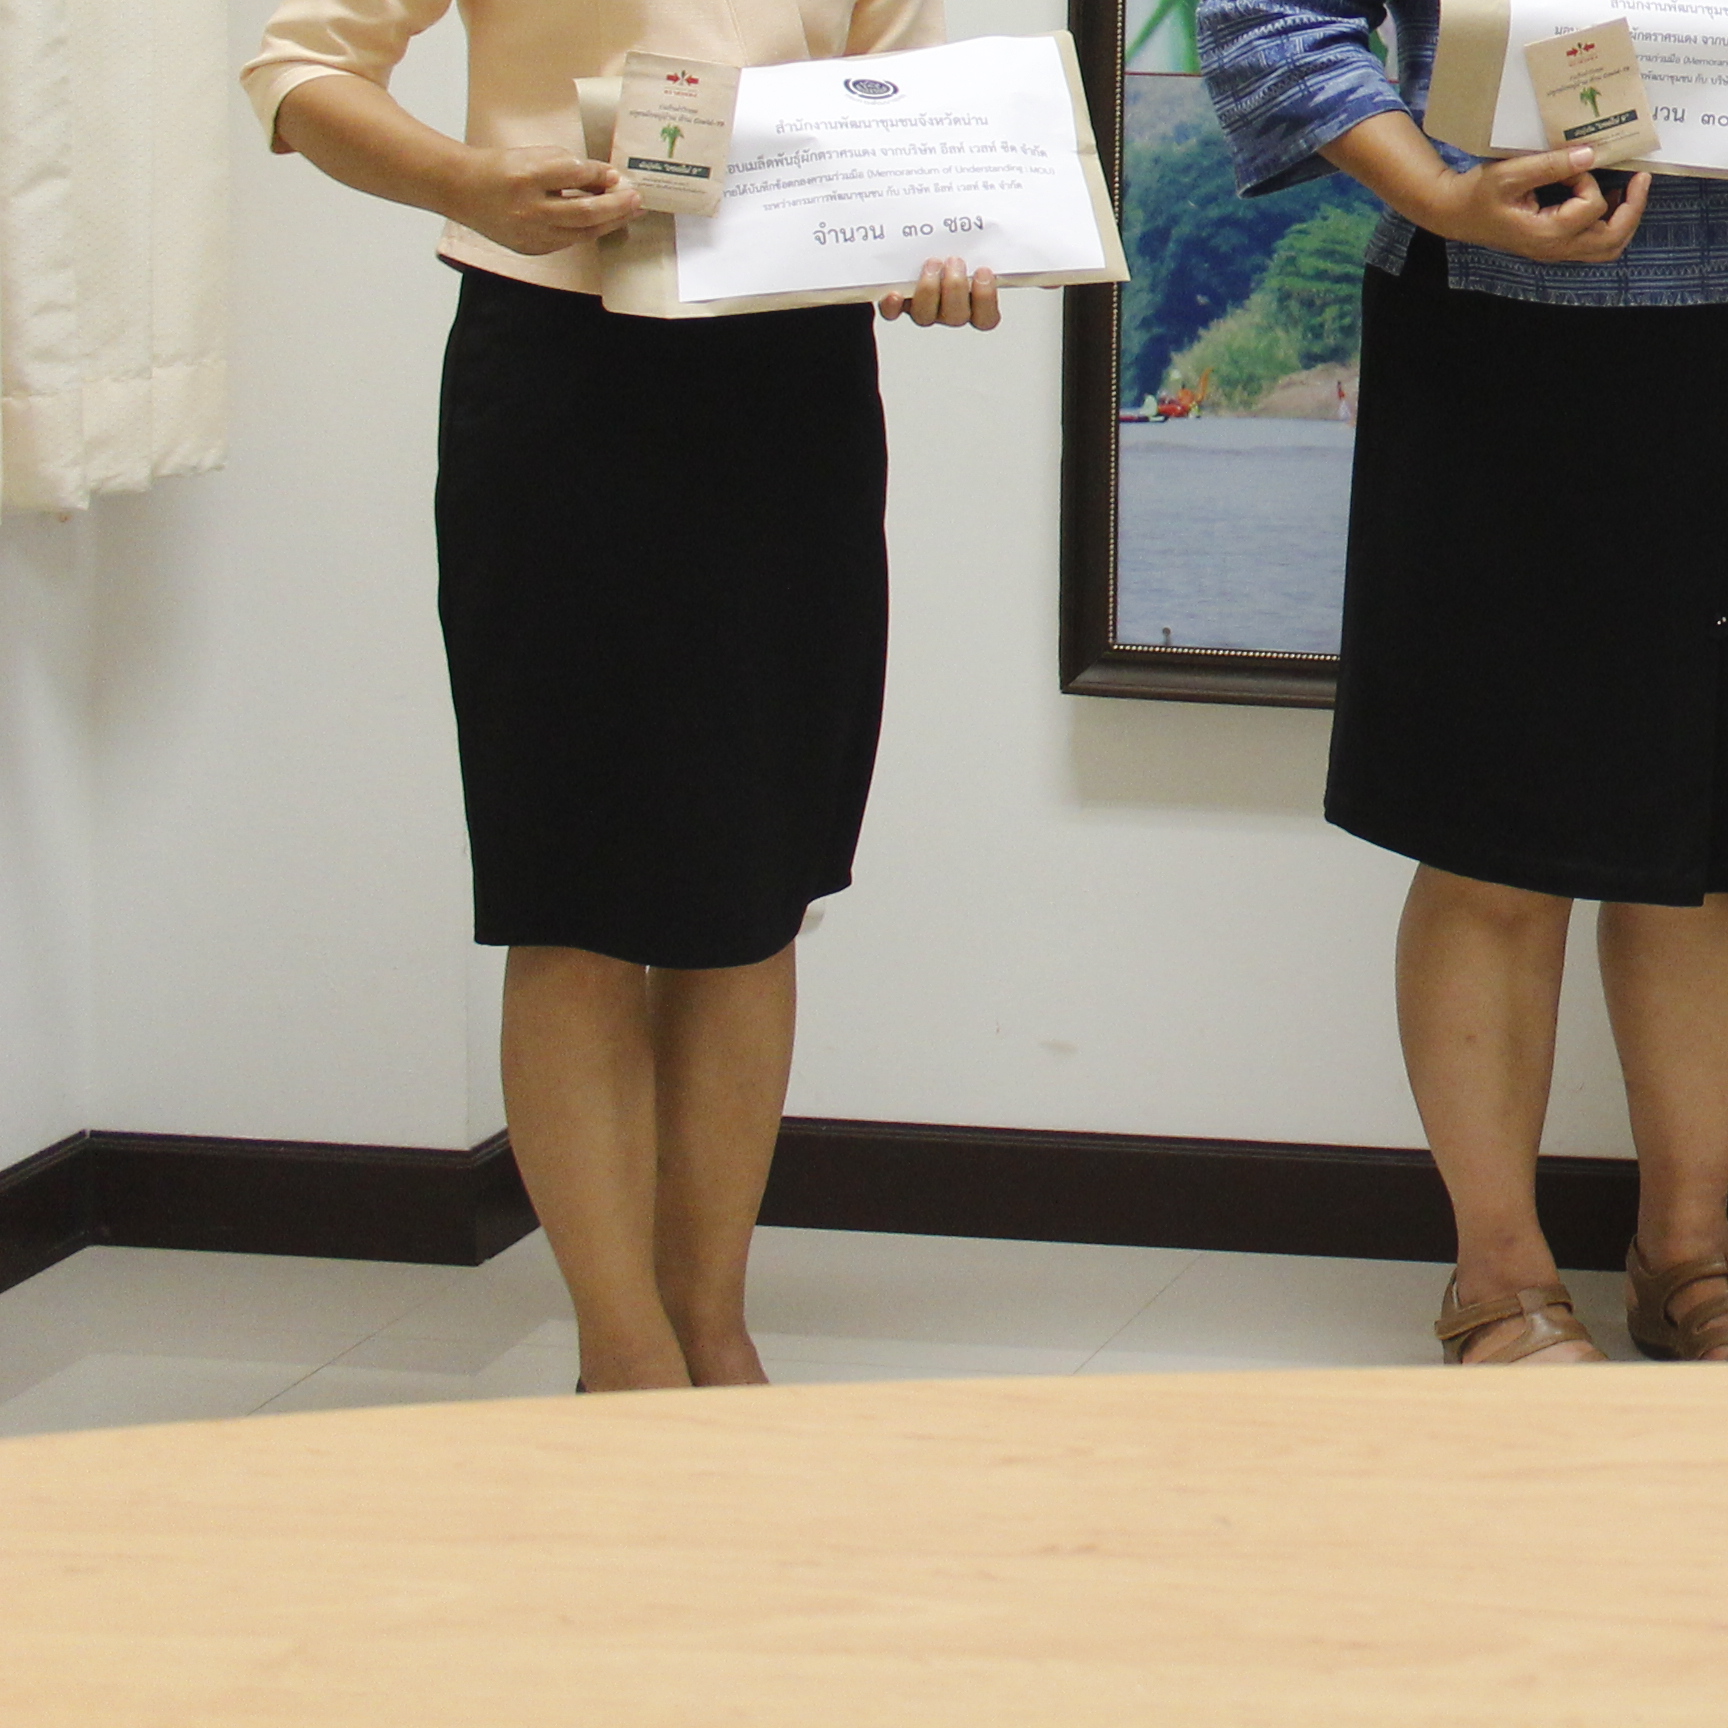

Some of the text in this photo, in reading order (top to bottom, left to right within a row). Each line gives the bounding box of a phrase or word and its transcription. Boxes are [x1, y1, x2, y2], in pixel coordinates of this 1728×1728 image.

[775, 112, 989, 135] สำนักงานพัฒนาชุมชนจังหวัดน่าน
[726, 147, 877, 175] อบเมล็ดพันธุ์ผักตราศรแดง
[880, 142, 937, 158] จากบริษัท
[942, 165, 953, 175] of
[812, 221, 886, 245] จำนวน
[902, 223, 934, 238] ๓๐
